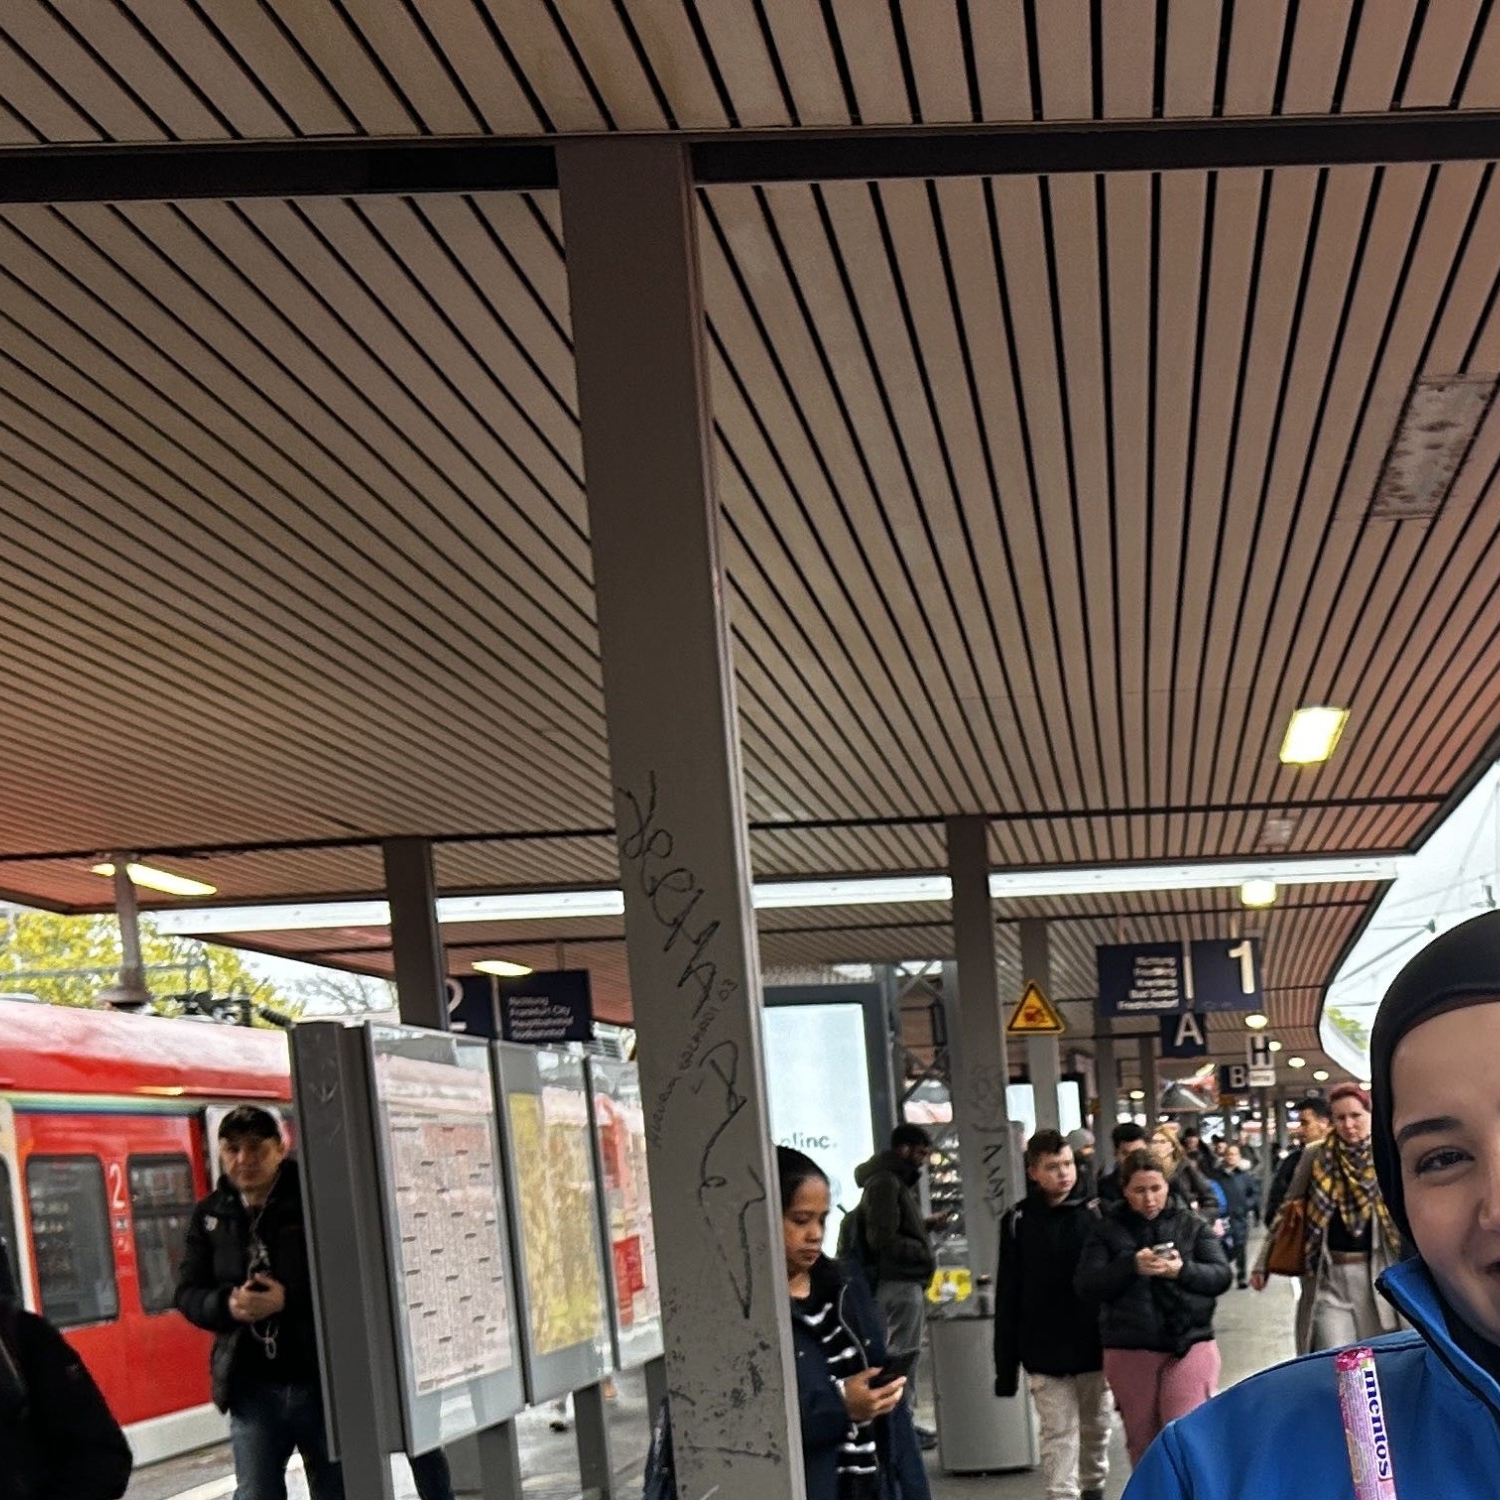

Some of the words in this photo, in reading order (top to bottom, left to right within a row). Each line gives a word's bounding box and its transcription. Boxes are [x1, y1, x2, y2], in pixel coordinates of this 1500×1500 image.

[1228, 940, 1255, 994] 1
[1174, 1011, 1204, 1047] A
[1250, 1036, 1270, 1066] H
[1229, 1065, 1247, 1088] B
[109, 1162, 125, 1209] 2
[1363, 1368, 1389, 1477] mentos
